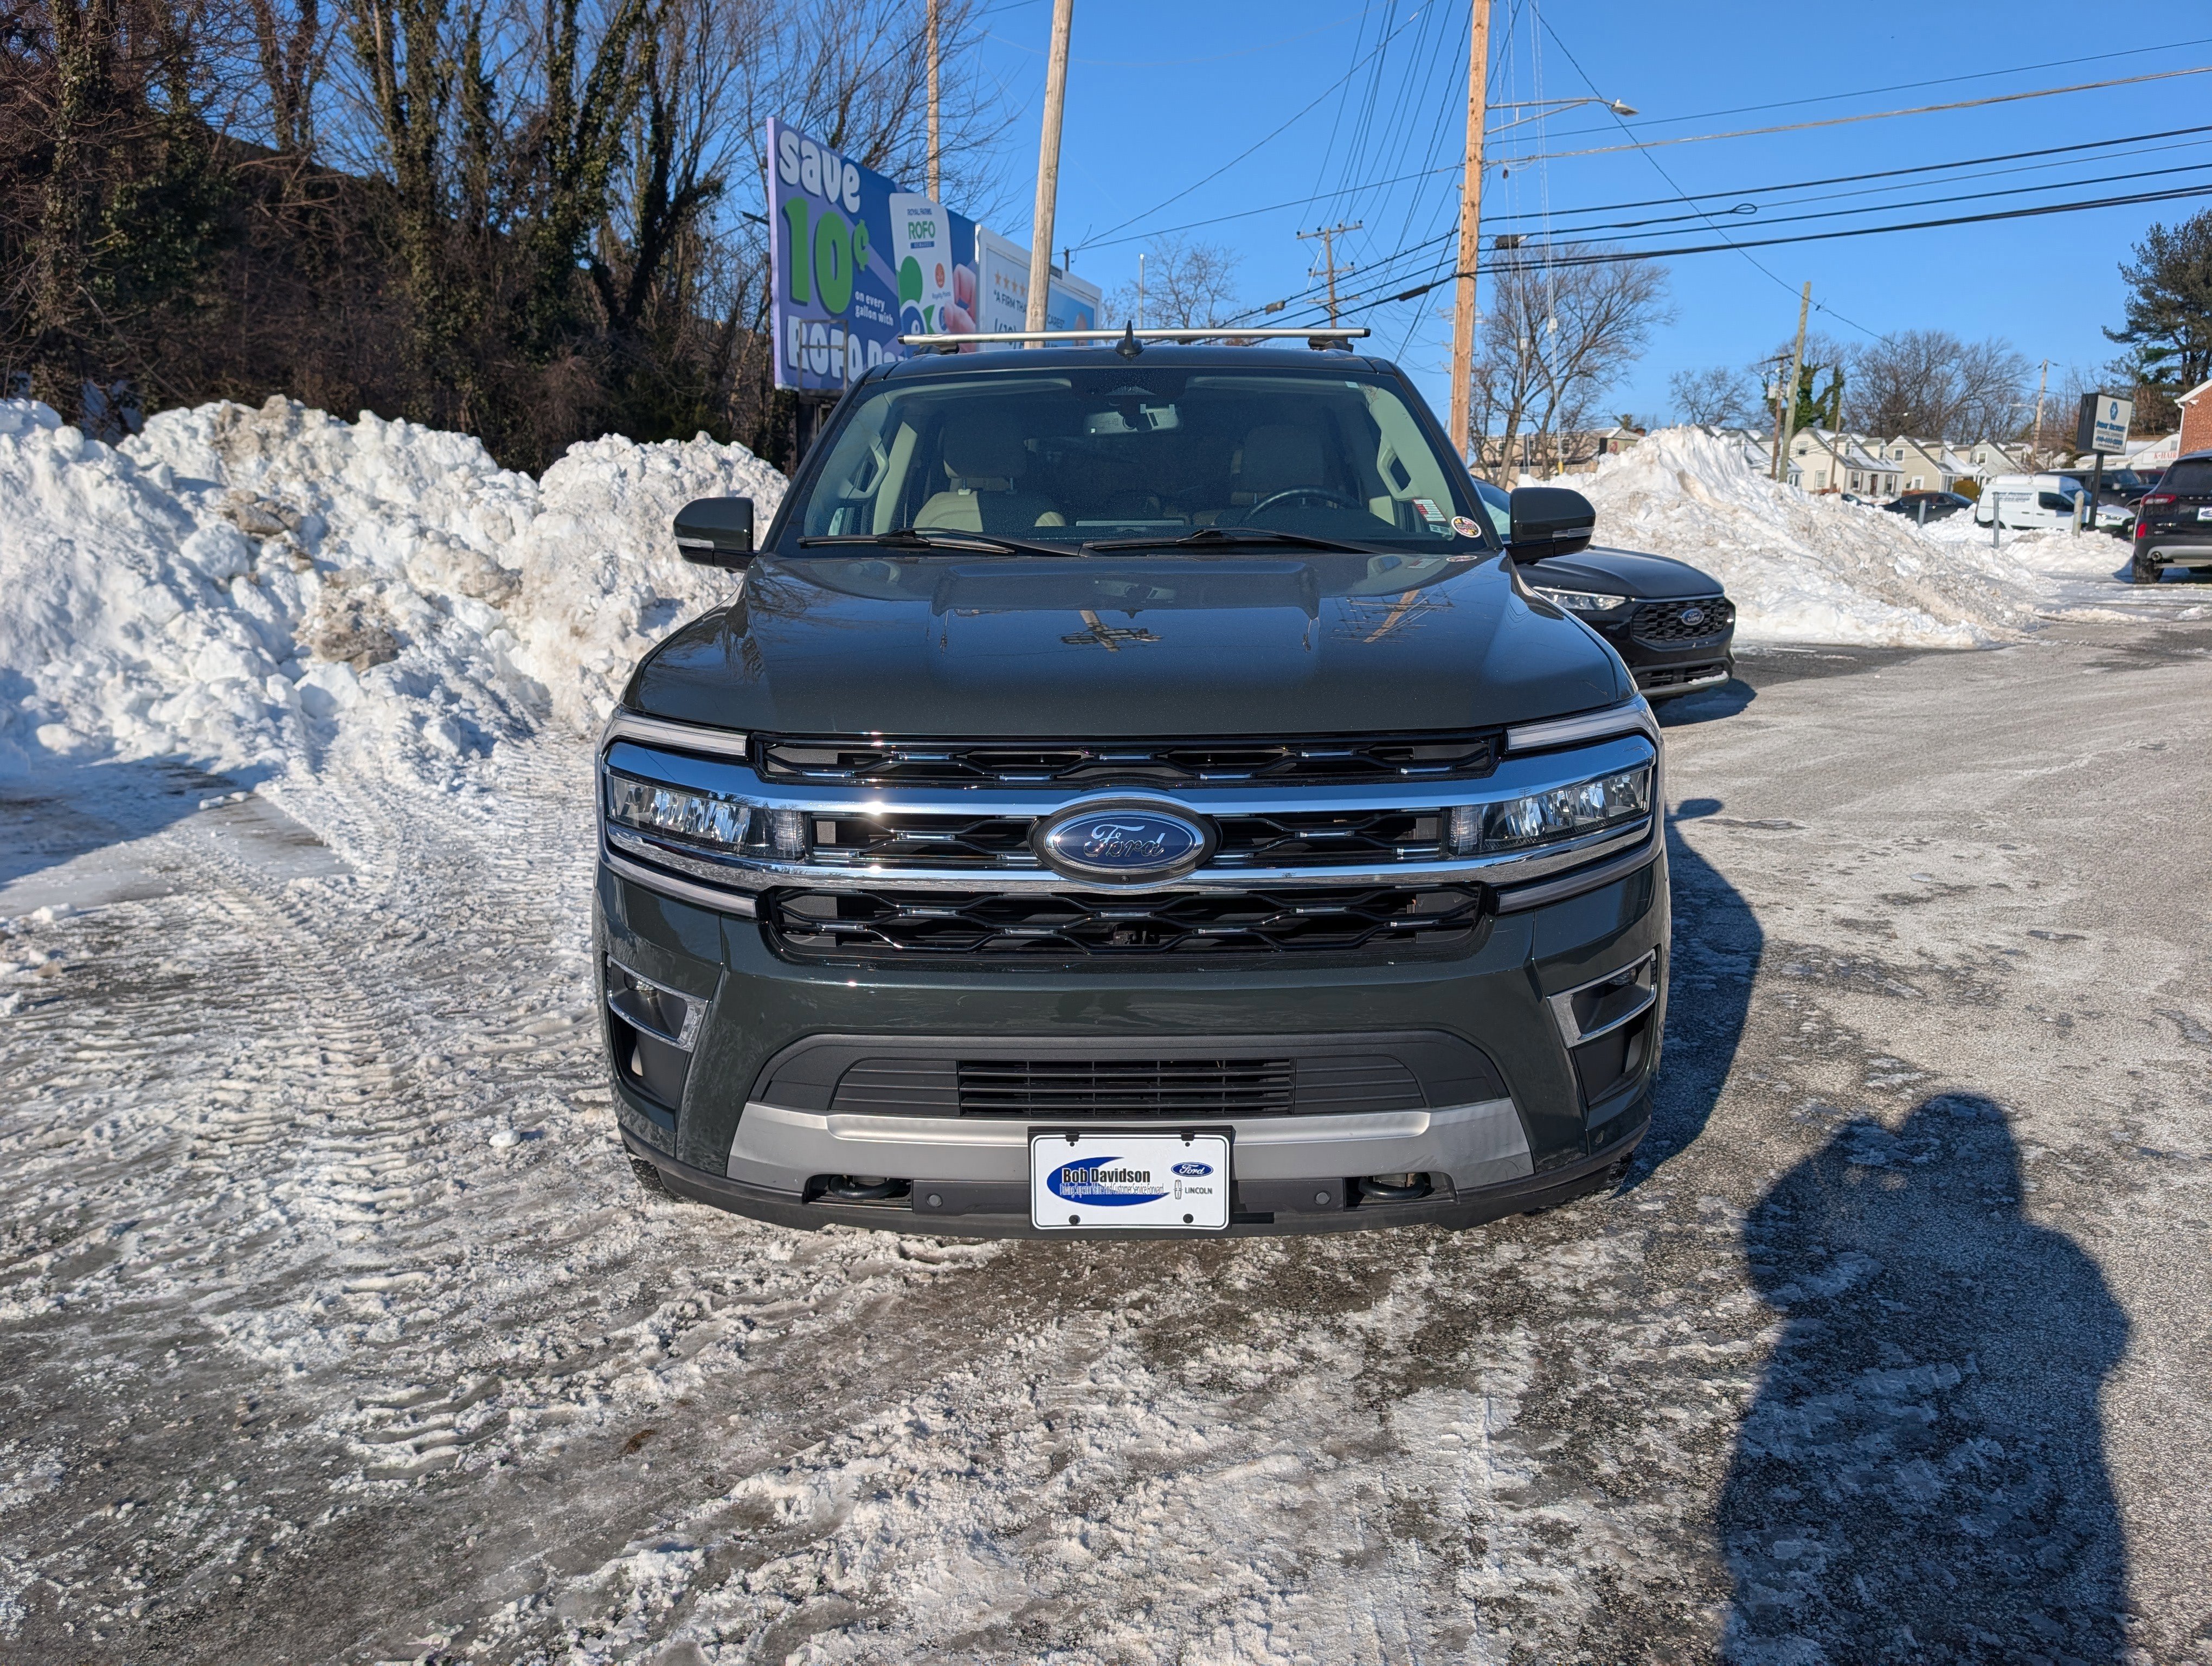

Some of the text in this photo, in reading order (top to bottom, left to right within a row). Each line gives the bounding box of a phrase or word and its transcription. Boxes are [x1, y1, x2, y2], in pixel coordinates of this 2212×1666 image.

[908, 220, 936, 240] ROFO
[784, 196, 870, 315] 10¢
[854, 290, 885, 313] on every
[854, 305, 894, 326] gallon with
[1084, 824, 1166, 857] Ford
[1063, 1168, 1150, 1183] Bob Davidson
[1179, 1164, 1206, 1175] Ford
[1113, 1183, 1132, 1195] Customer
[1132, 1183, 1147, 1195] Service
[1147, 1183, 1164, 1195] Forward
[1184, 1187, 1213, 1195] LINCOLN
